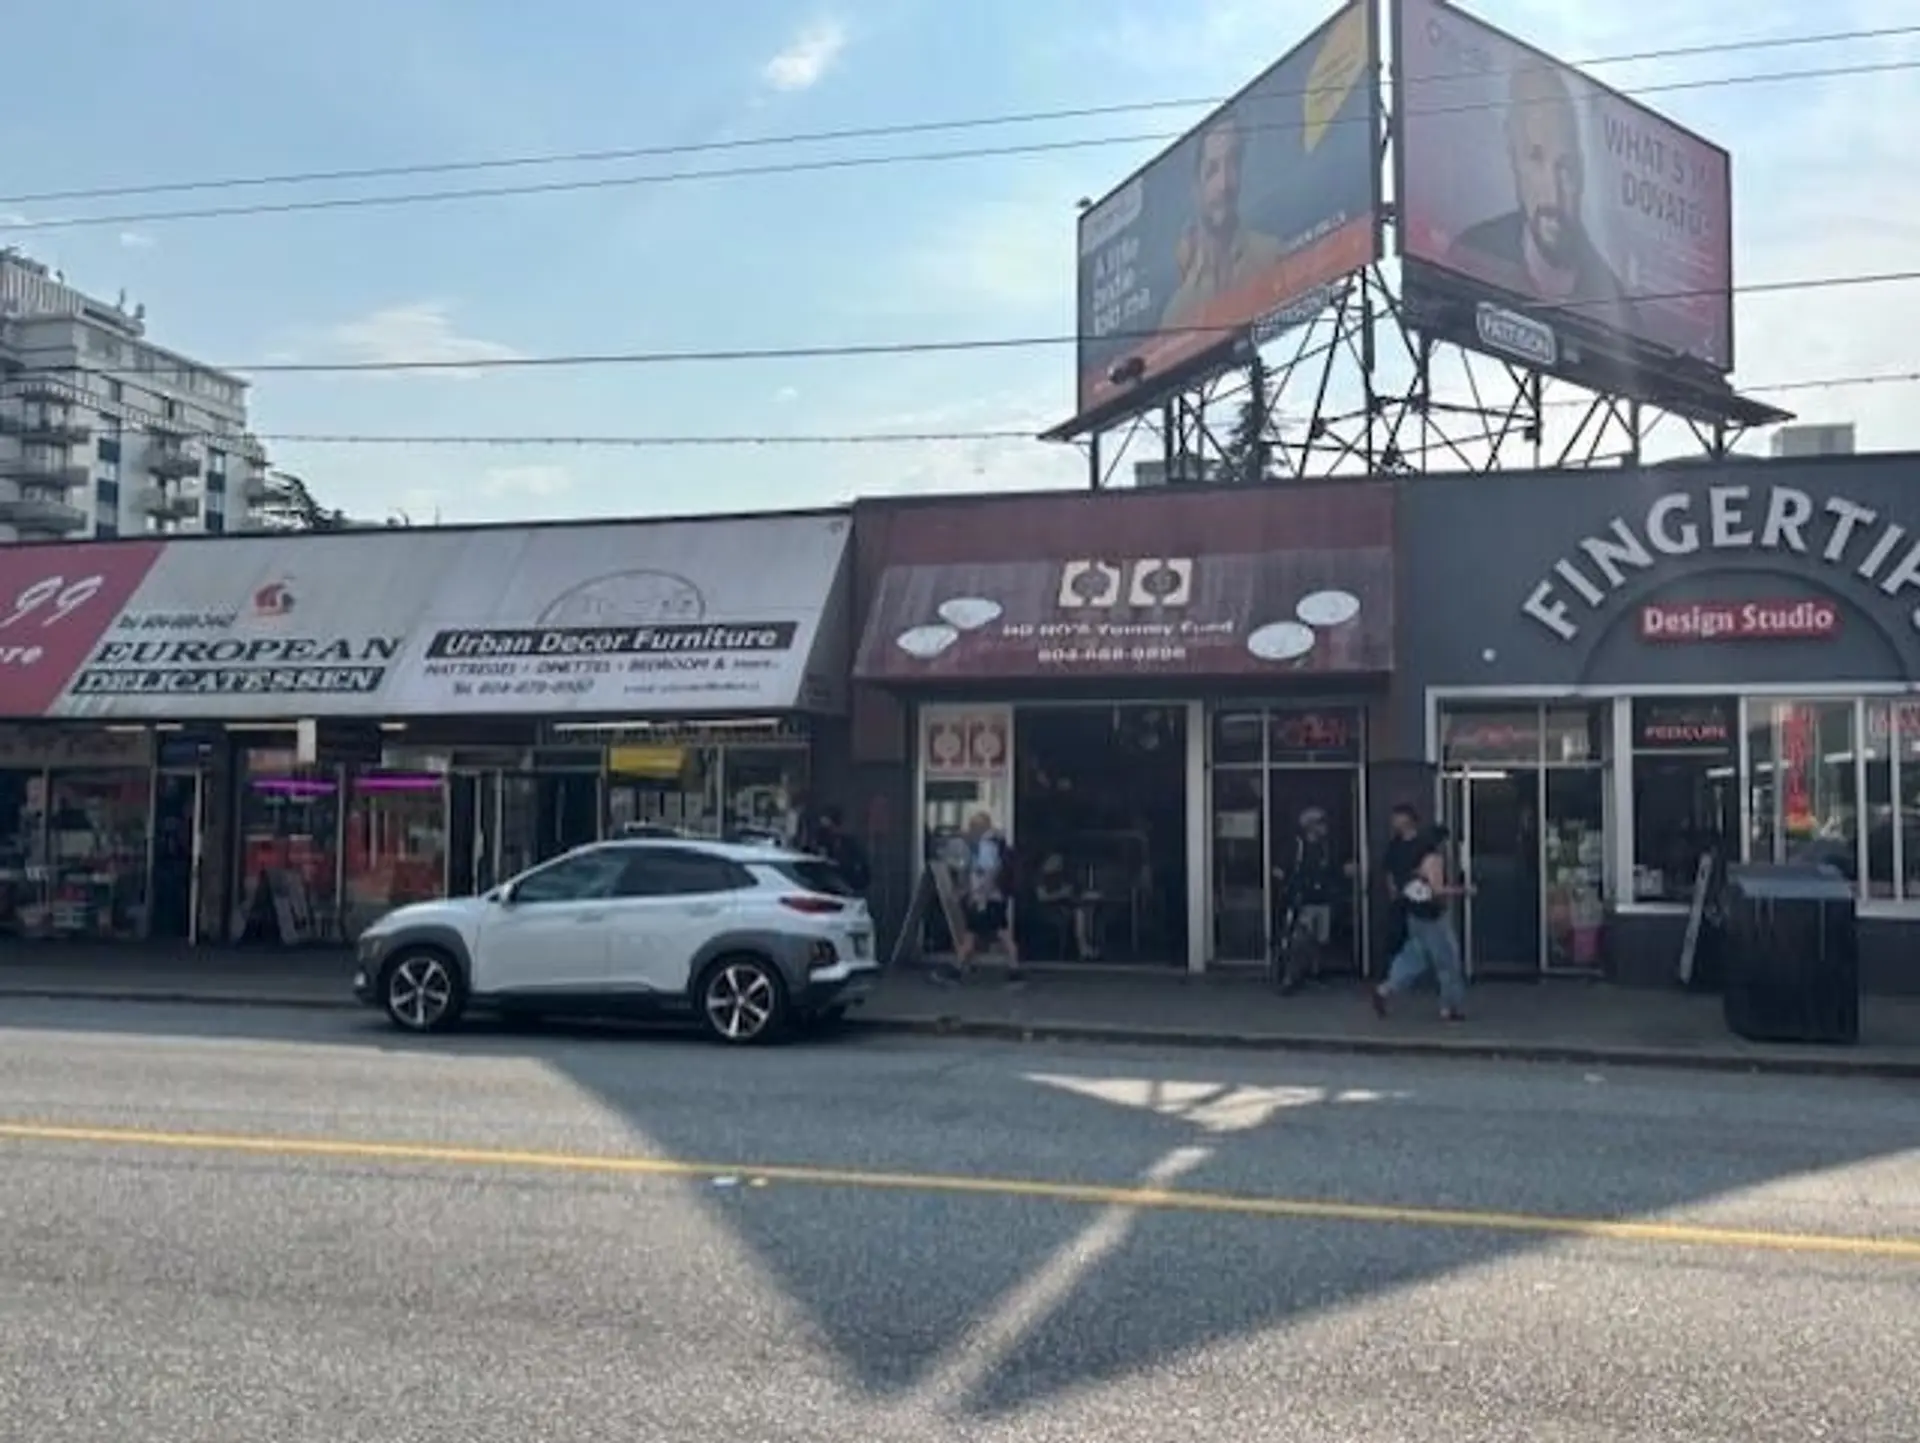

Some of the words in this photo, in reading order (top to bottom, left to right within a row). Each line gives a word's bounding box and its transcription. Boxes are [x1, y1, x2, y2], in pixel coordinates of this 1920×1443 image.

[1521, 485, 1920, 640] FINGERTIP
[1643, 606, 1735, 636] Design
[1742, 602, 1835, 631] Studio
[97, 637, 402, 663] EUROPEAN
[445, 631, 533, 656] Urban
[539, 629, 626, 654] Decor
[632, 626, 778, 651] Furniture
[80, 666, 374, 693] DELICATESSEN
